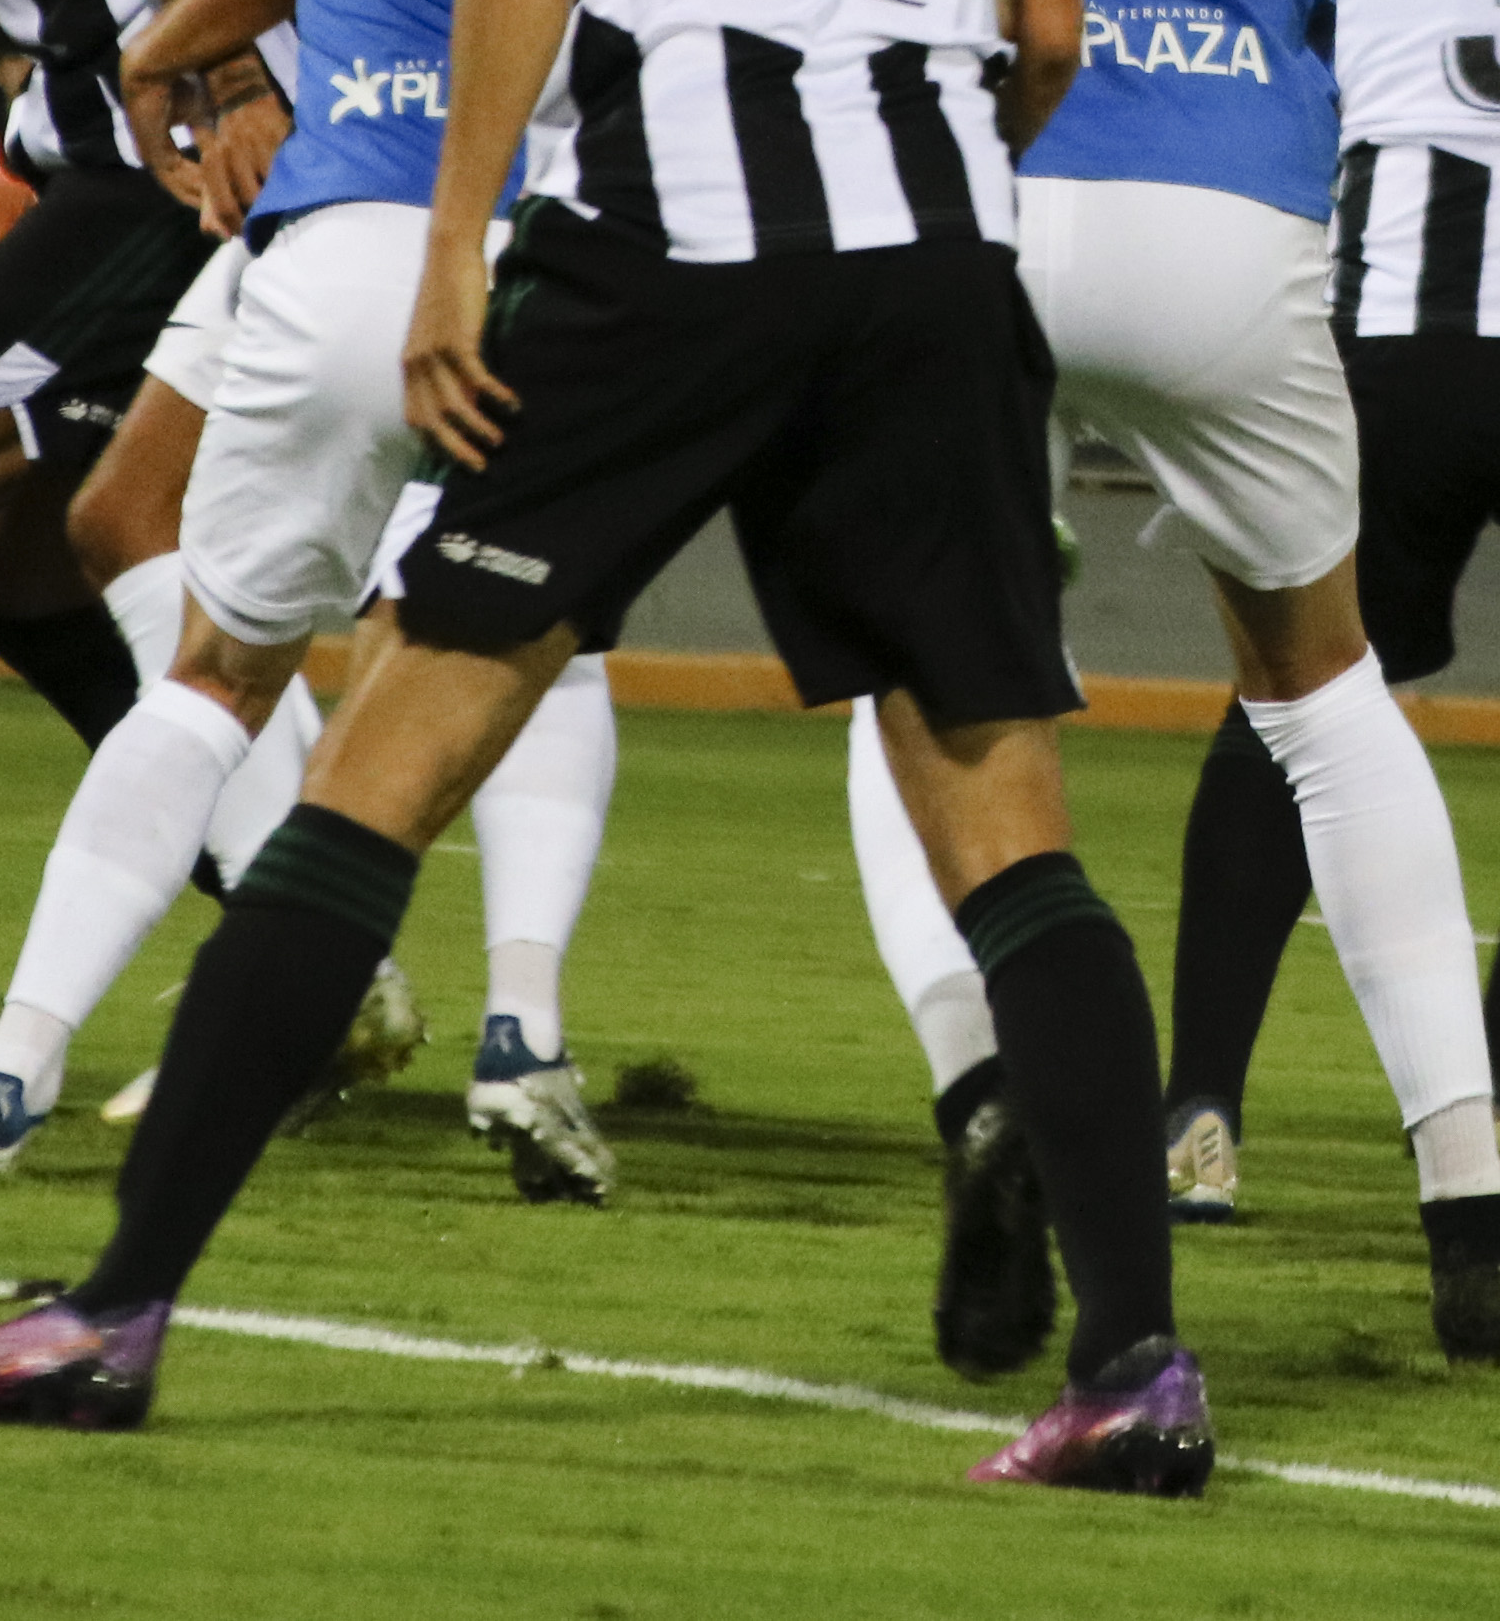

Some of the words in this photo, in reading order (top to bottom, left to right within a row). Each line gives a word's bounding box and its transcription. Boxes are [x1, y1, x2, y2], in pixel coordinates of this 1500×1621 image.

[1117, 6, 1225, 21] FERNANDO
[1079, 11, 1271, 86] PLAZA
[392, 72, 449, 119] PL
